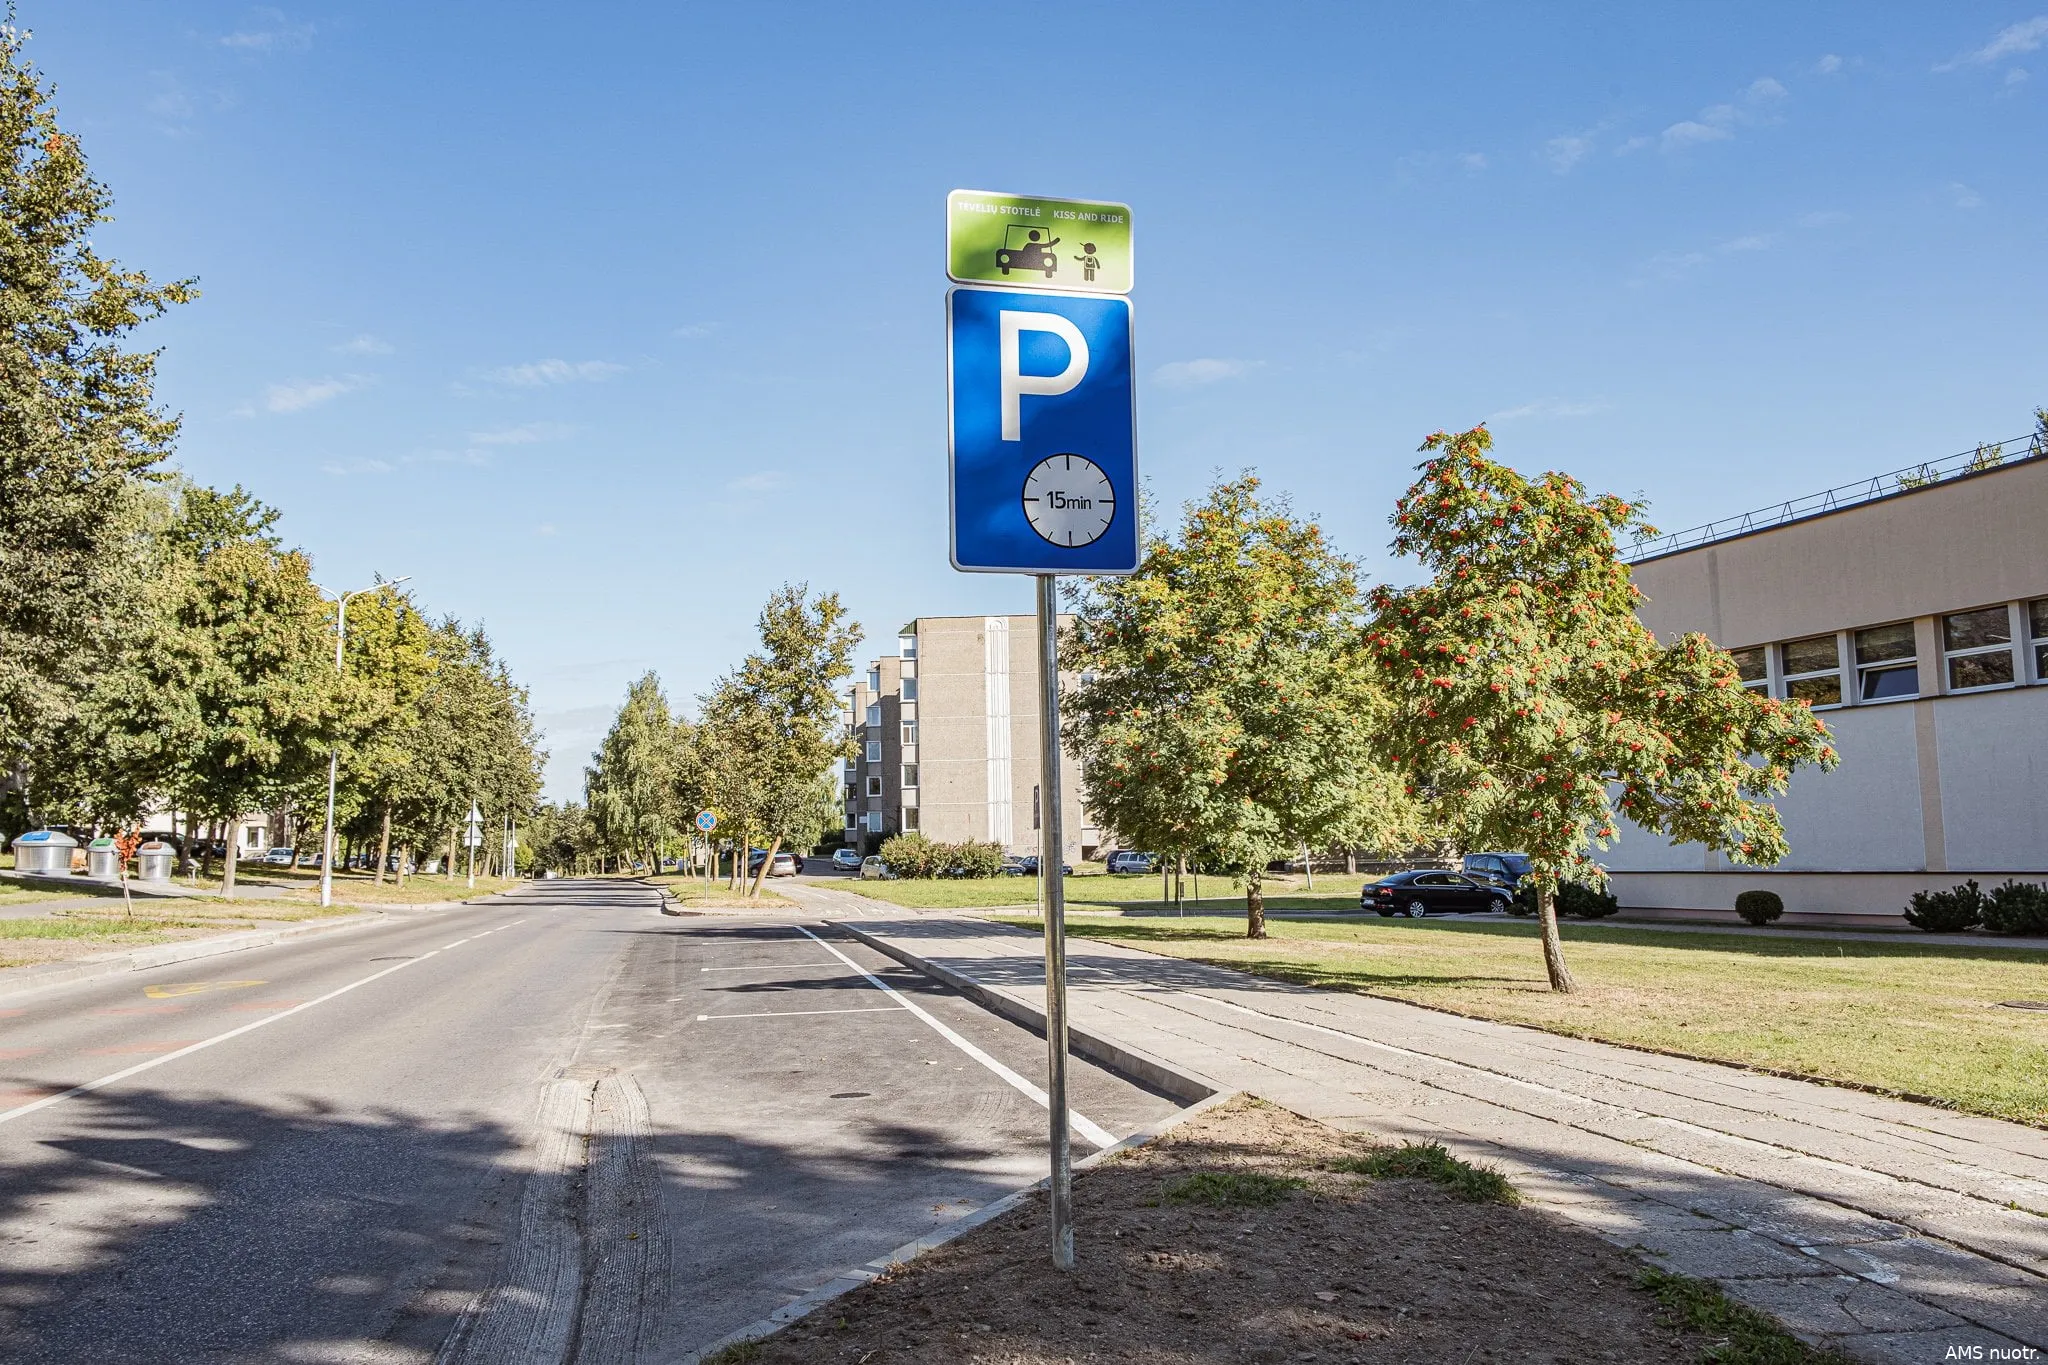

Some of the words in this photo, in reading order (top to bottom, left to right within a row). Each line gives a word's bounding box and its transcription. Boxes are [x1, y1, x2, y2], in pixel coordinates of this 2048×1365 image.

[1000, 206, 1041, 217] STOTELĖ
[1053, 210, 1076, 220] KISS
[1078, 212, 1098, 221] AND
[1100, 214, 1124, 224] RIDE
[1000, 310, 1089, 441] P
[1046, 490, 1092, 510] 15min
